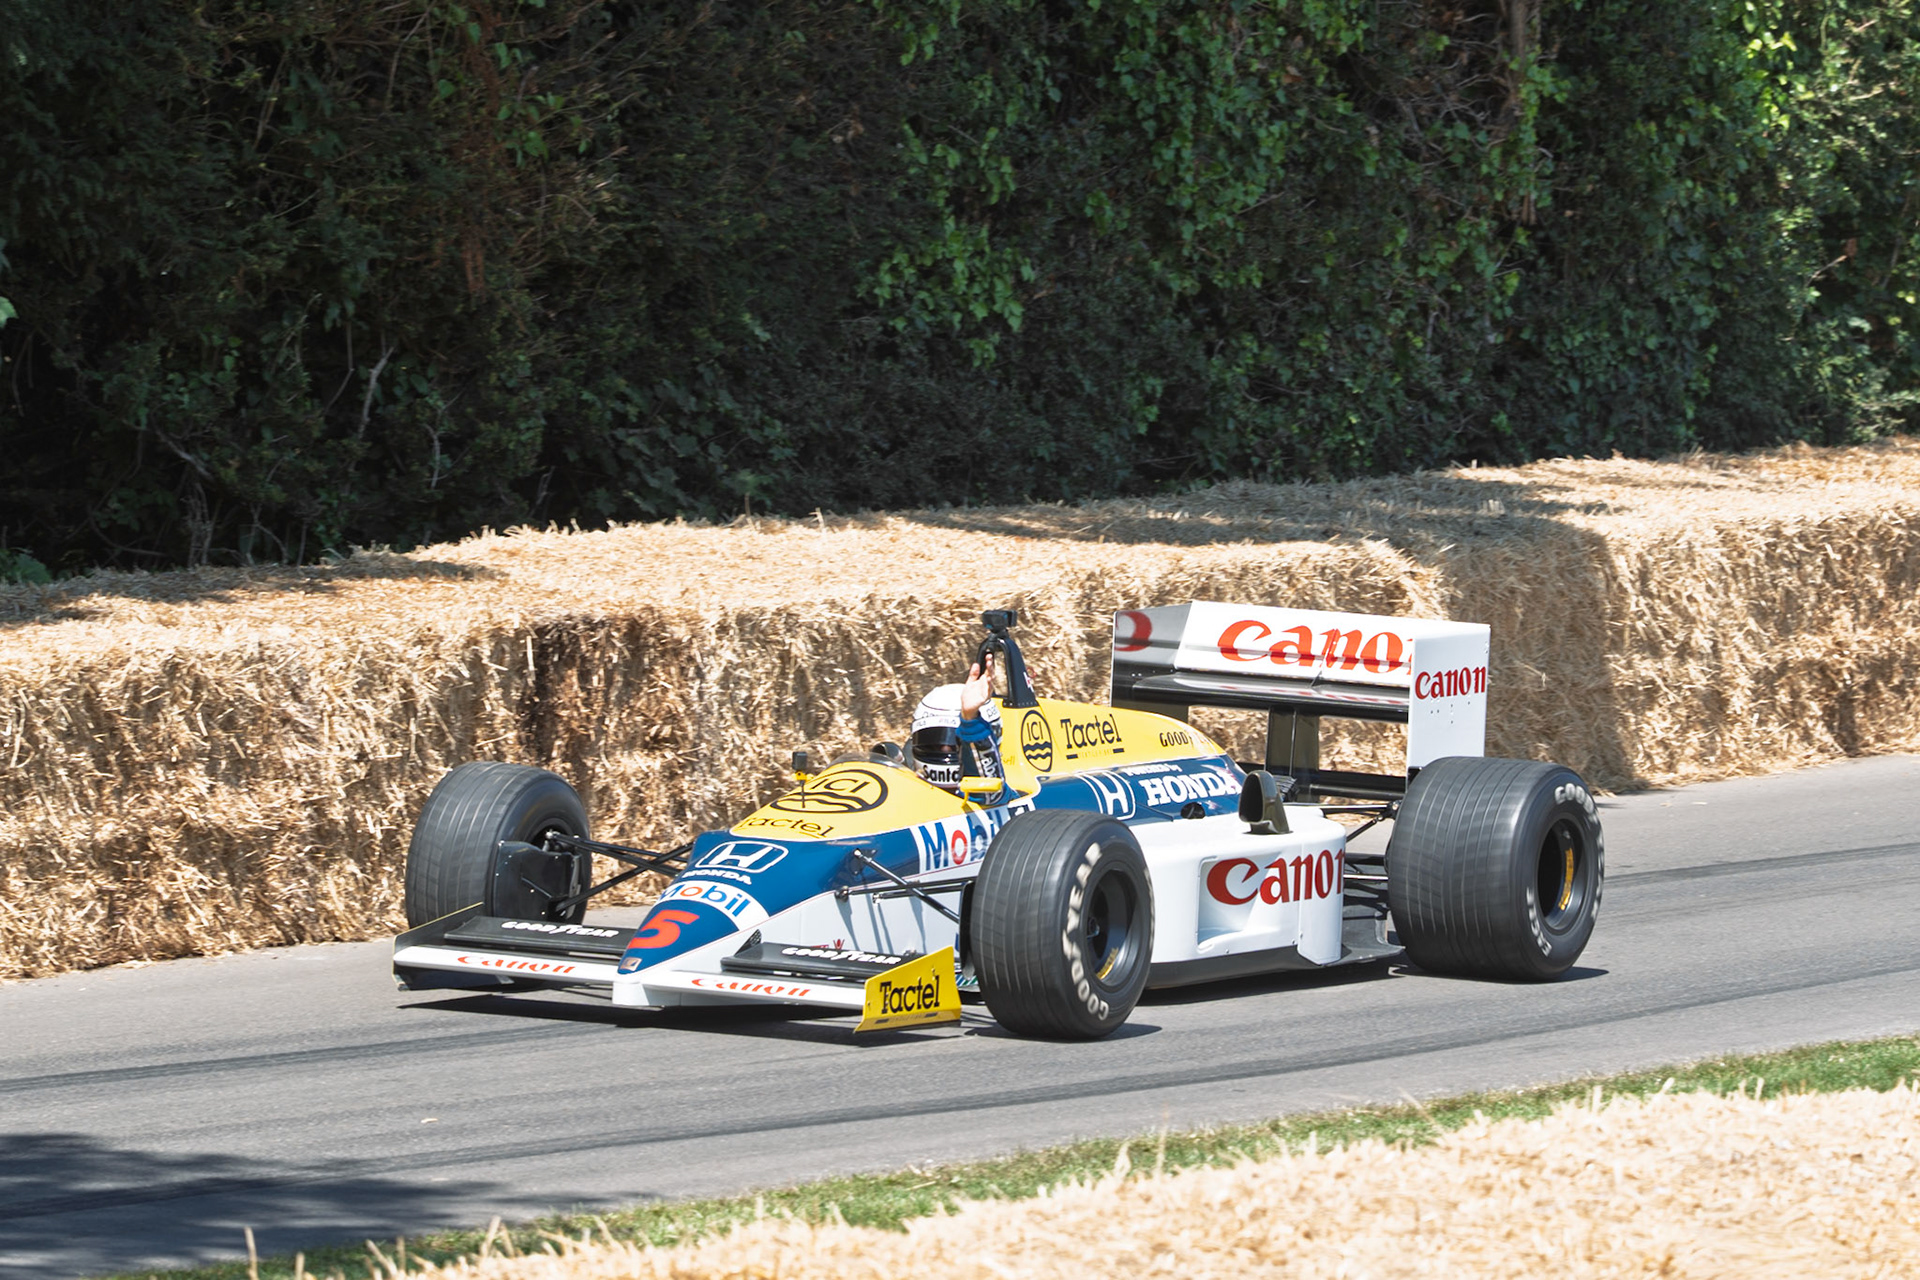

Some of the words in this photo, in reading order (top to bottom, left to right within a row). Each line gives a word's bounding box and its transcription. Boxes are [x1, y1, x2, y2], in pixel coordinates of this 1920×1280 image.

[1217, 620, 1412, 675] Cano
[1415, 666, 1487, 699] Canon
[1026, 721, 1044, 741] ICI
[1060, 713, 1122, 749] Tactel
[1159, 731, 1190, 747] GOOD
[811, 778, 871, 793] ICI
[1138, 772, 1243, 806] HONDA
[682, 869, 752, 885] HONDA
[660, 884, 751, 917] Mobil
[501, 921, 619, 938] GOODYEAR
[628, 910, 700, 949] 5
[458, 955, 576, 974] Canon
[781, 947, 902, 964] GOODYEAR
[691, 978, 811, 996] Canon
[879, 974, 940, 1014] Tactel
